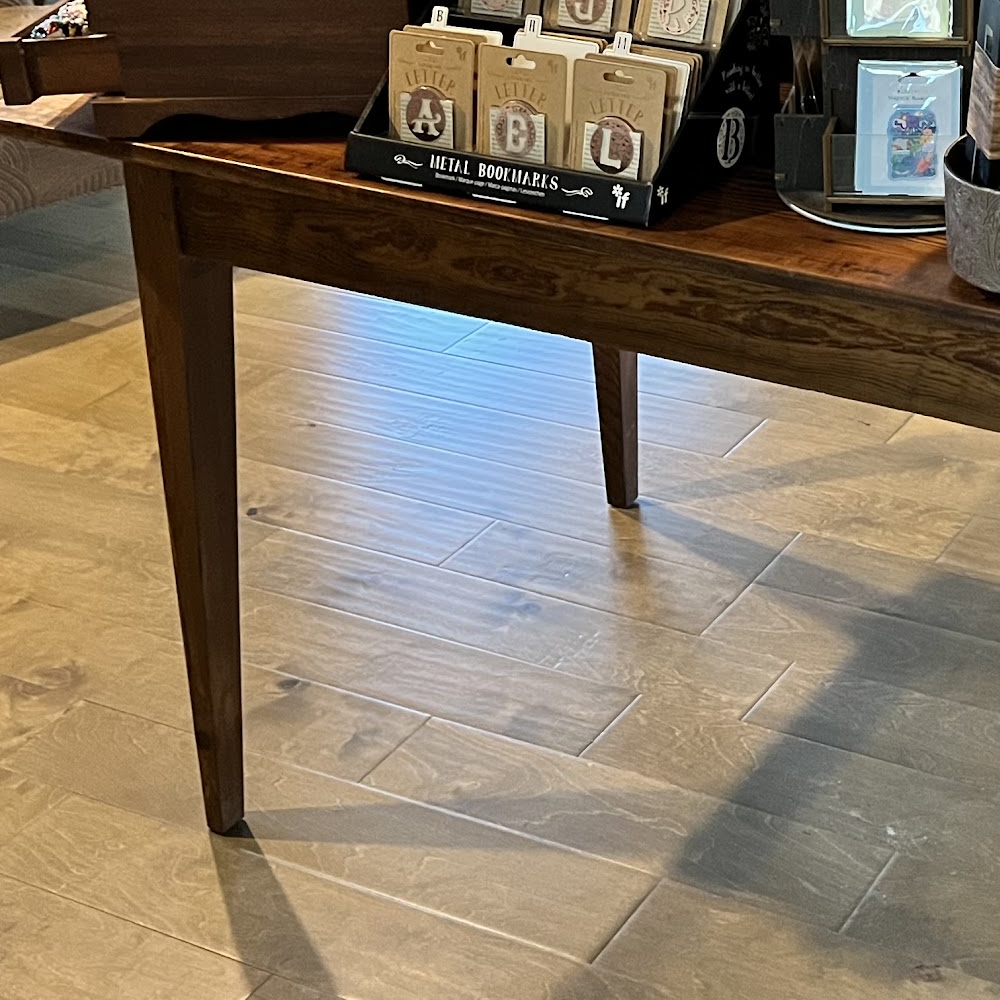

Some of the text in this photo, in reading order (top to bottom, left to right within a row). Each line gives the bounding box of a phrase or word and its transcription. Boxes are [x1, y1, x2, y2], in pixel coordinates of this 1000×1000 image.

[404, 70, 456, 92] LETTER
[494, 83, 548, 106] LETTER
[411, 99, 442, 136] A
[590, 100, 644, 122] LETTER
[506, 114, 526, 152] E
[600, 128, 622, 170] L
[429, 154, 472, 176] METAL
[478, 162, 560, 192] BOOKMARKS
